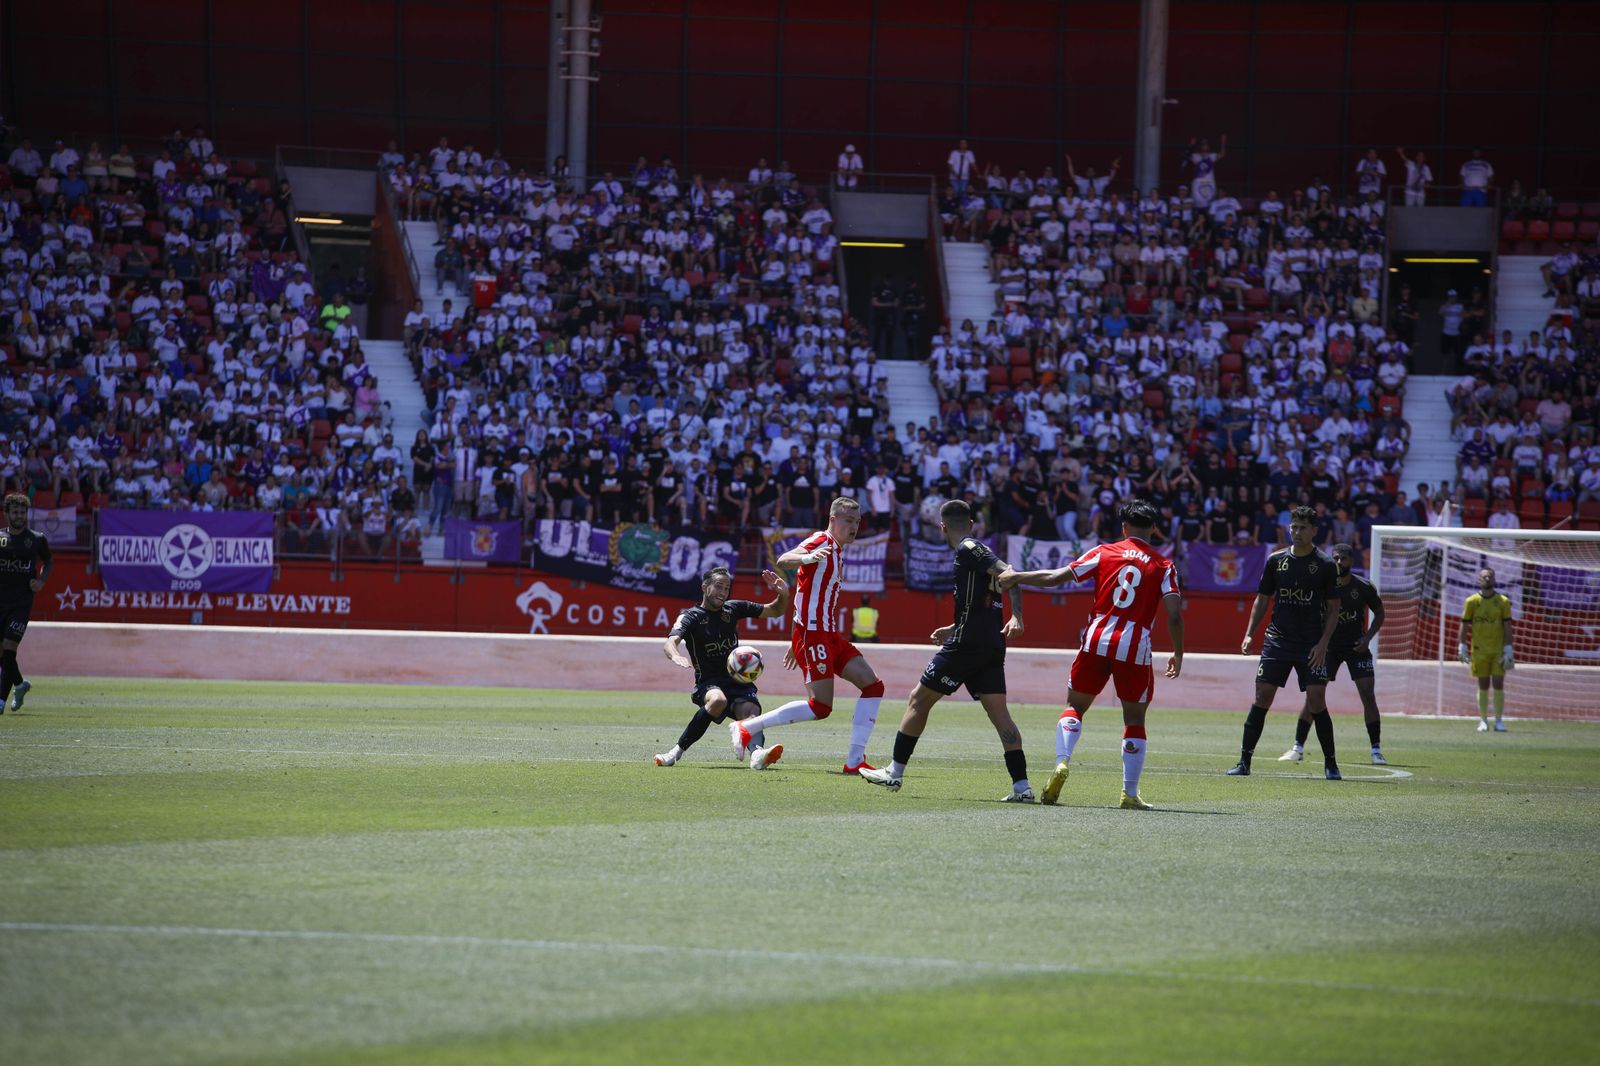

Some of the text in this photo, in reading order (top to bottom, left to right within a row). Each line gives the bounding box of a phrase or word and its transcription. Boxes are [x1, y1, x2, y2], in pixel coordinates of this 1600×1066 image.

[101, 538, 270, 564] CRUZADA BLANCA
[1122, 549, 1151, 564] JOAN
[1277, 557, 1289, 571] 16
[171, 580, 202, 591] 2009
[1112, 565, 1142, 609] 8
[83, 589, 351, 614] ESTRELLA DE LEVANTE
[566, 603, 670, 627] COSTA
[808, 643, 828, 662] 18
